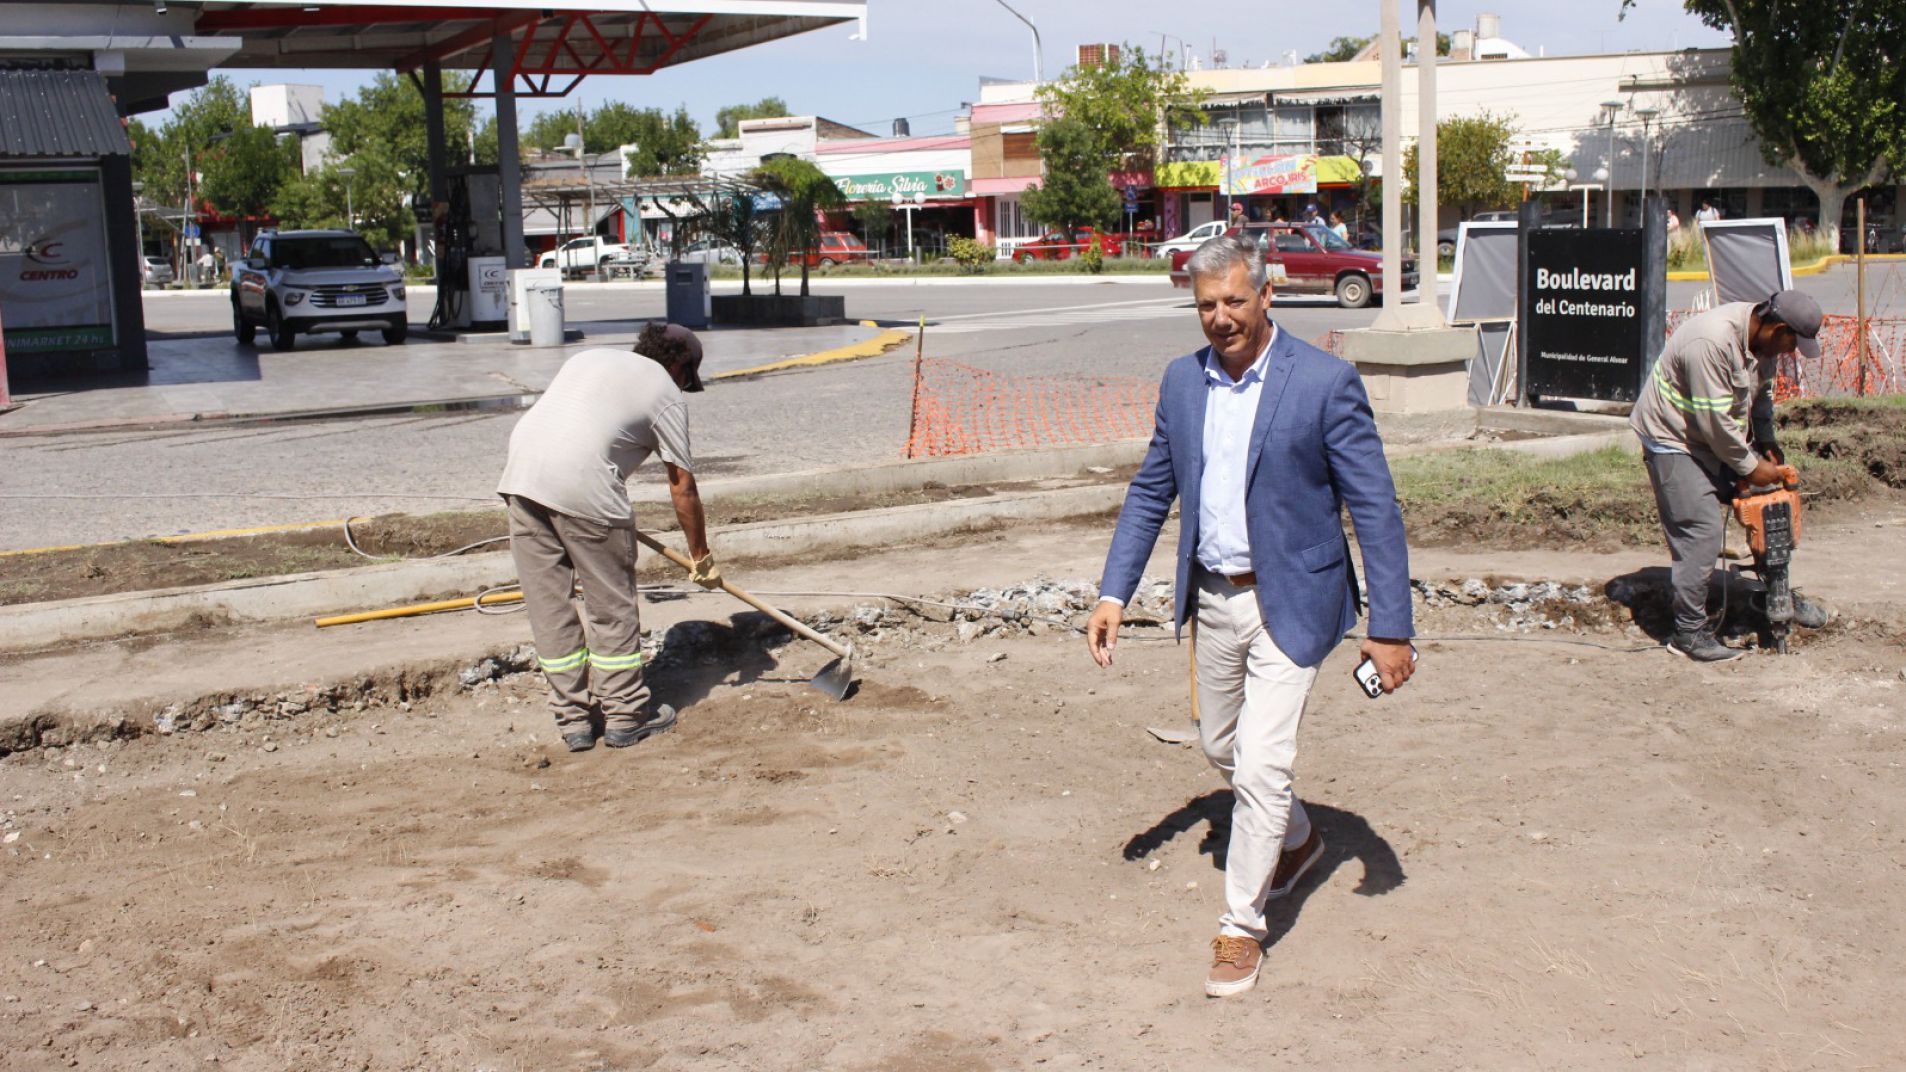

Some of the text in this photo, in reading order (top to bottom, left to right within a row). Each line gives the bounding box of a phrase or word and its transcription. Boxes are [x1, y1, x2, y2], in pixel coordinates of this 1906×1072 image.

[888, 175, 928, 193] Silvia
[1254, 175, 1285, 188] ARCO
[20, 270, 79, 281] CENTRO
[1536, 267, 1635, 290] Boulevard
[1536, 298, 1635, 318] del Centenario
[1541, 351, 1578, 361] Municipalidad
[1587, 354, 1609, 363] General
